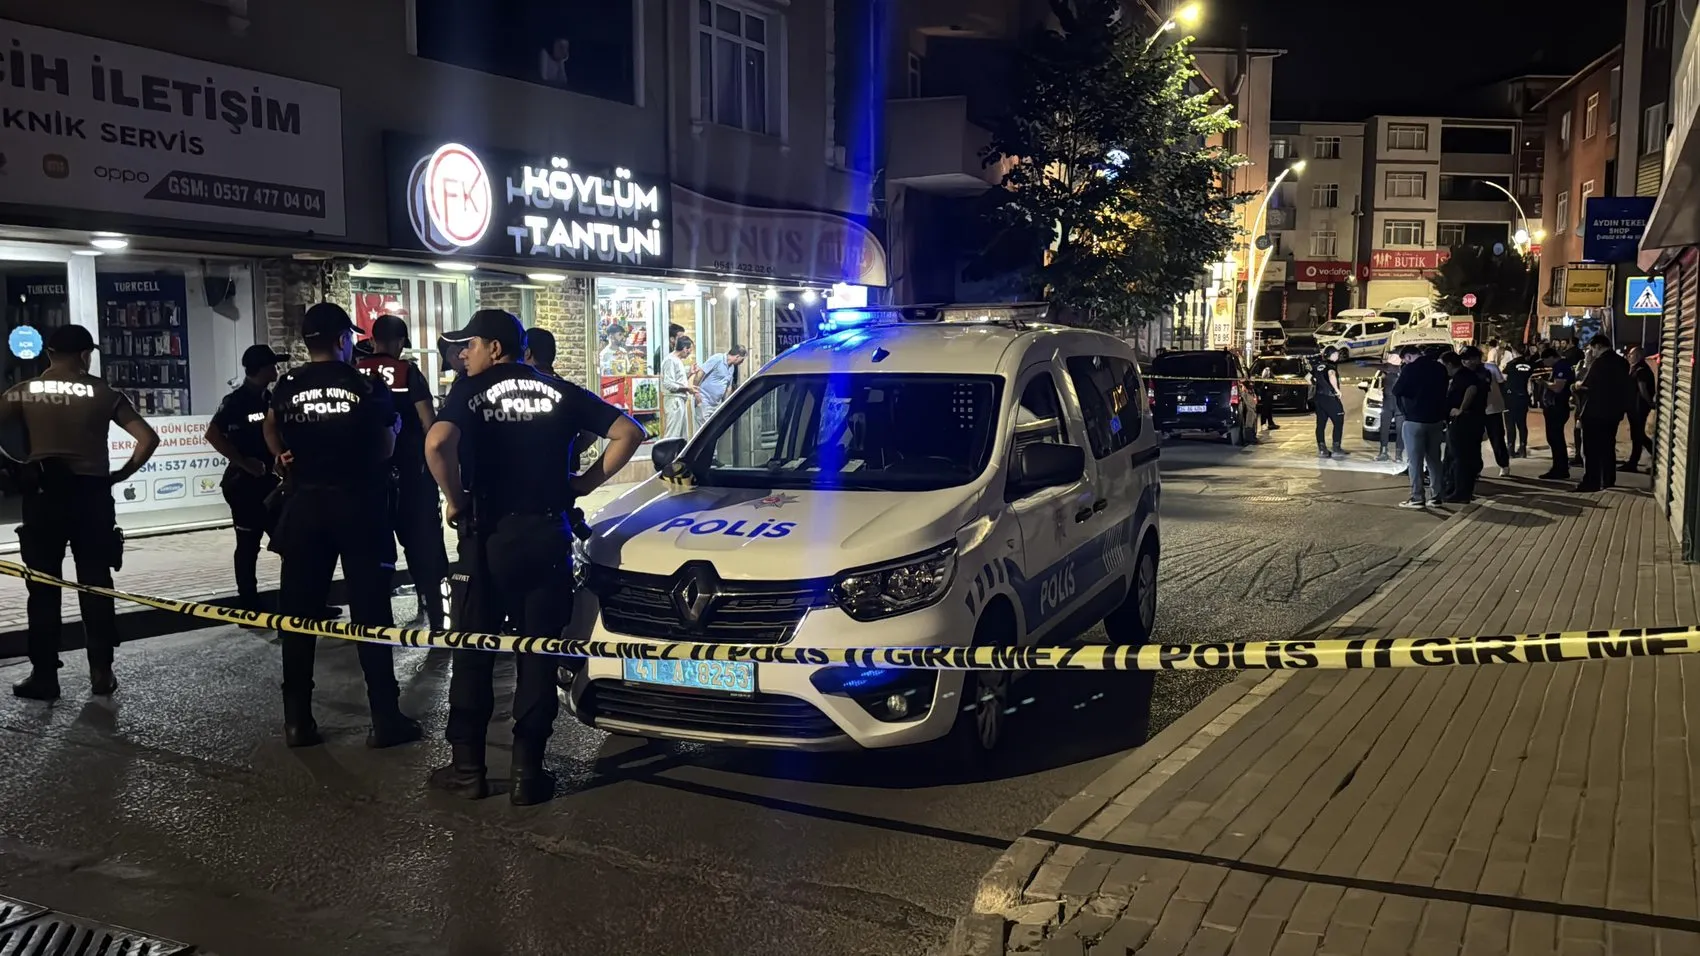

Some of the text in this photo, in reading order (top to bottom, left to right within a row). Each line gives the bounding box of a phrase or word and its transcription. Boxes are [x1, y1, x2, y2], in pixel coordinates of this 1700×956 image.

[0, 38, 300, 135] İH İLETİŞİM
[100, 122, 205, 156] SERVİS
[94, 166, 150, 184] oppo
[523, 156, 659, 213] KÖYLÜM
[168, 176, 321, 212] GSM: 0537 477 04 04
[1394, 254, 1426, 268] BUTİK
[1319, 267, 1352, 276] vodafon
[161, 424, 182, 434] GÜN
[112, 441, 139, 451] EKRA
[140, 462, 156, 473] SM
[165, 461, 187, 471] 537
[190, 459, 210, 469] 477
[212, 457, 227, 468] 04
[657, 518, 798, 540] POLİS
[1410, 625, 1700, 667] GİRİLME
